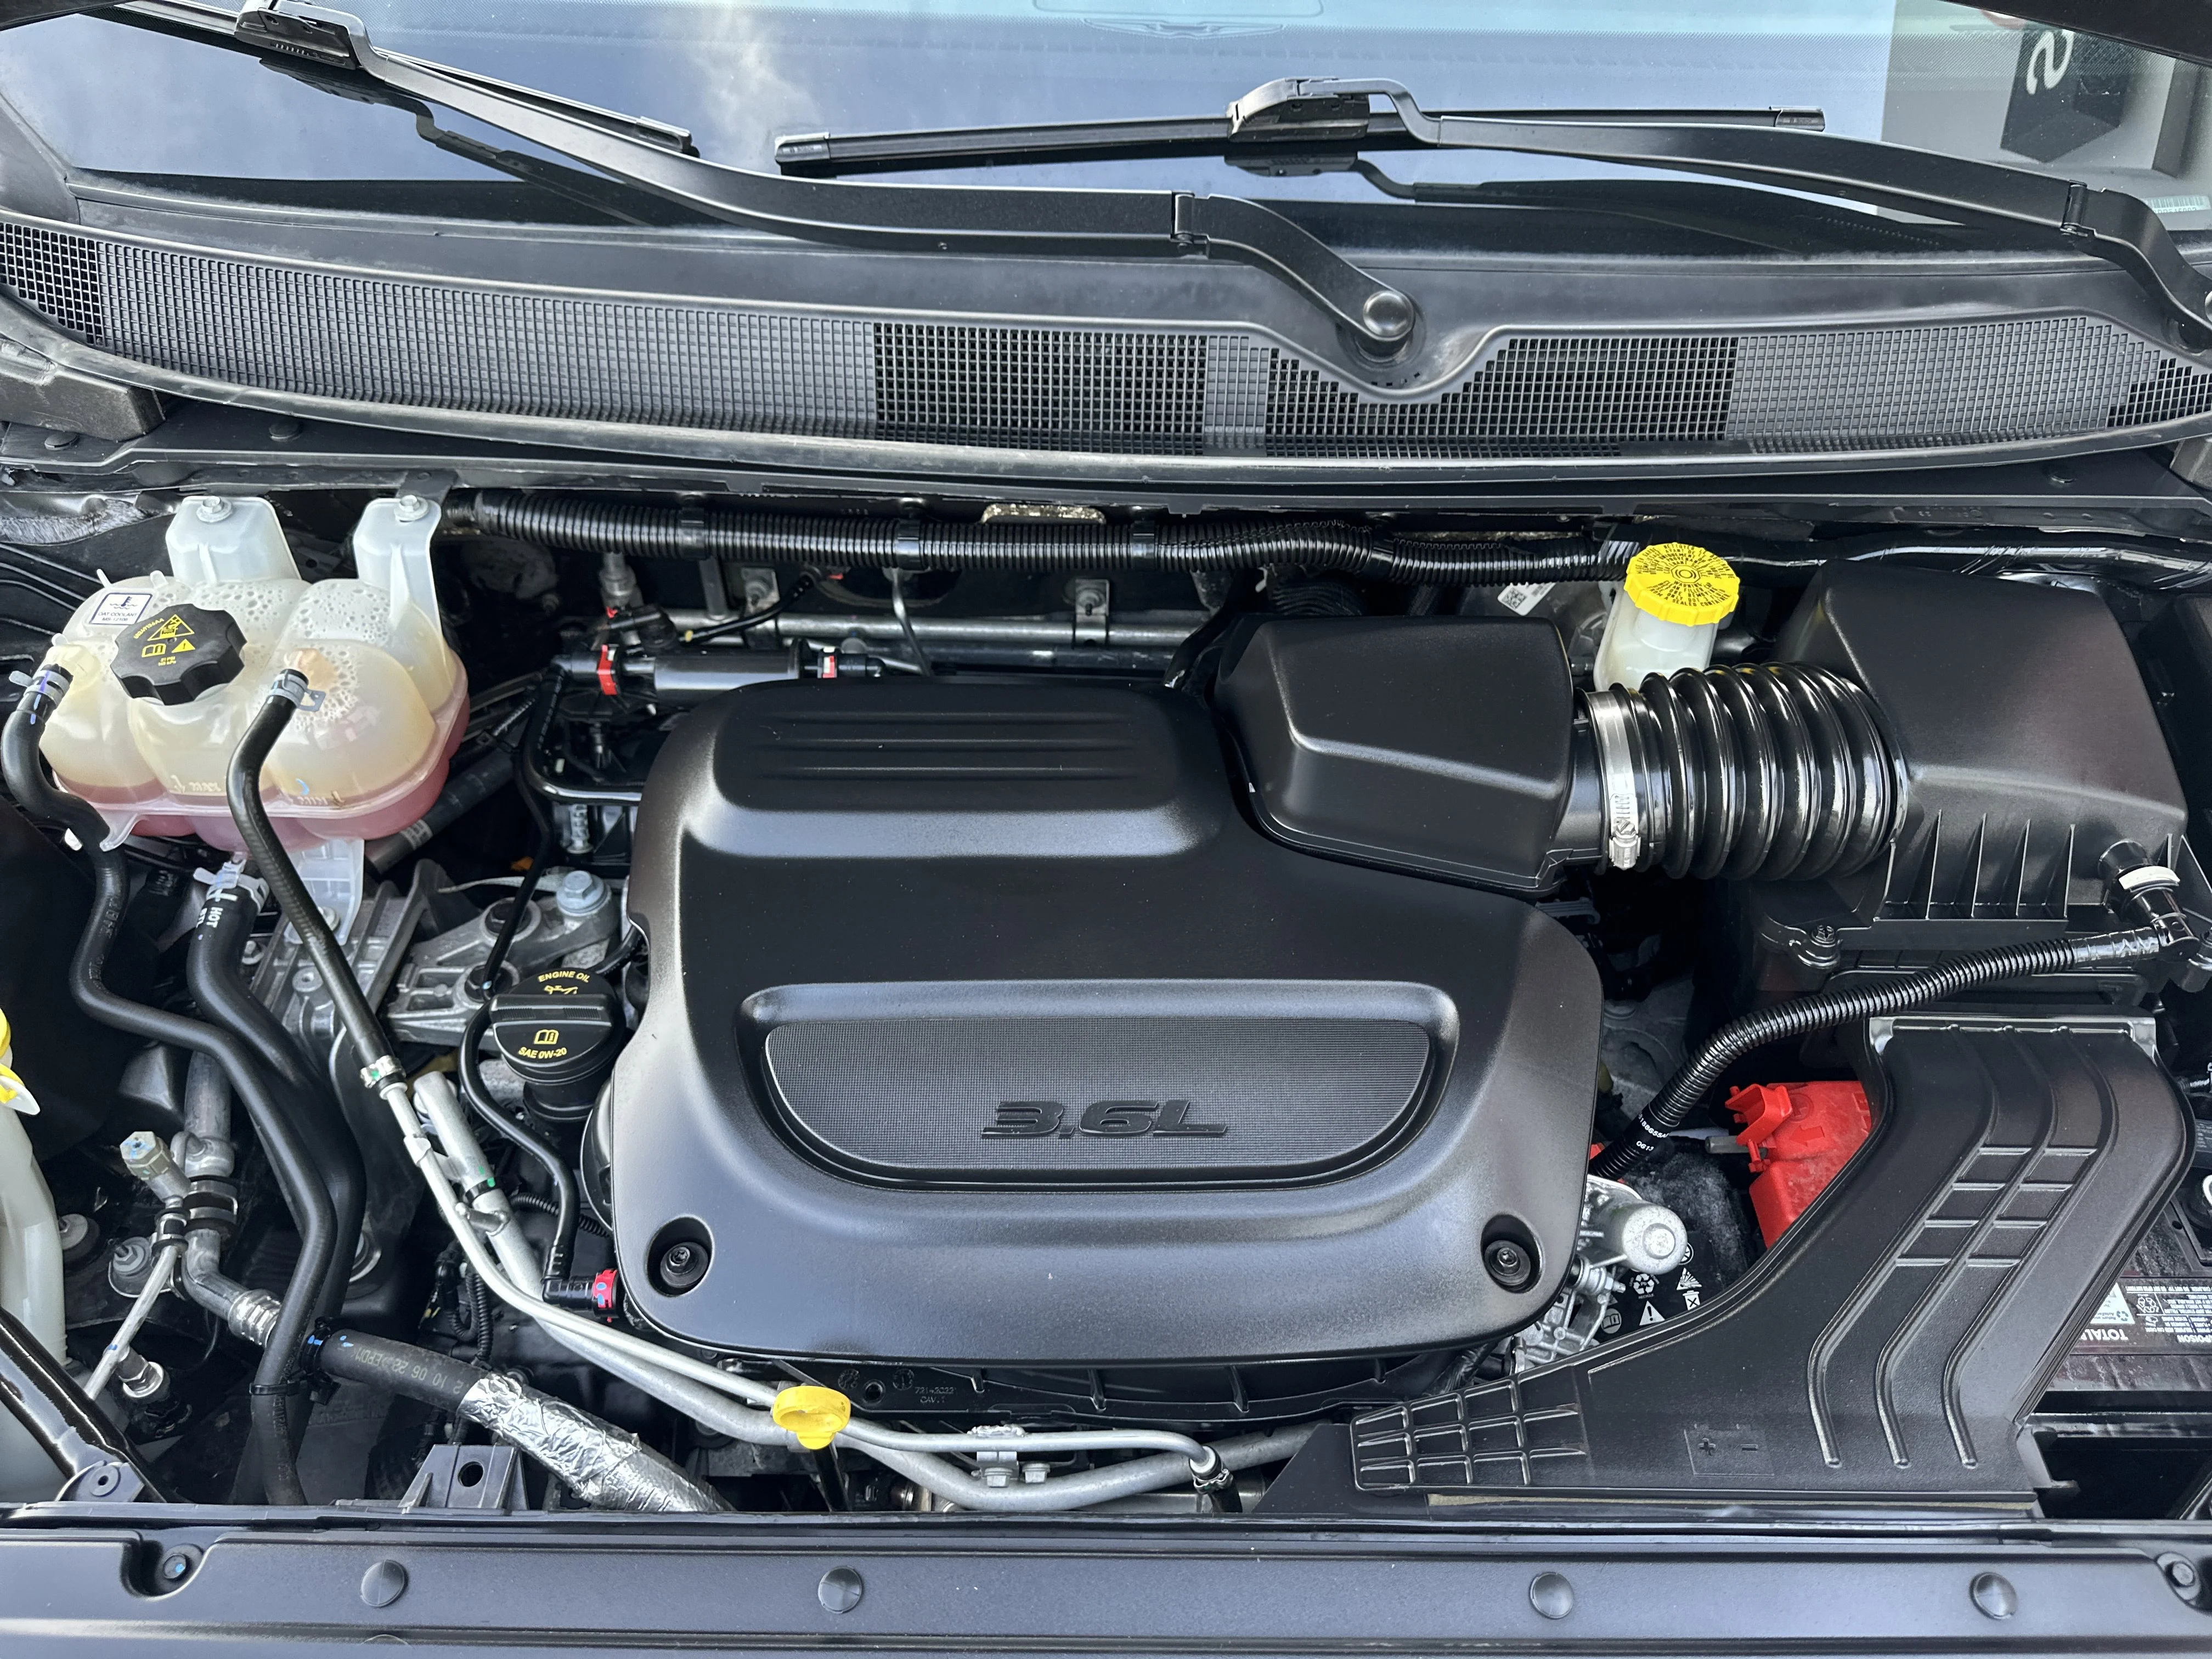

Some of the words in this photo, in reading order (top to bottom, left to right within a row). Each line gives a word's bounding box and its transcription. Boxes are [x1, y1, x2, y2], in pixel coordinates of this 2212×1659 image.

[1701, 594, 1730, 606] CONTAINER
[206, 907, 223, 928] HOT
[538, 970, 576, 983] ENGINE
[576, 973, 590, 983] OIL
[518, 1046, 538, 1059] SAE
[538, 1047, 567, 1059] 0W-20
[981, 1099, 1228, 1139] 3.6L
